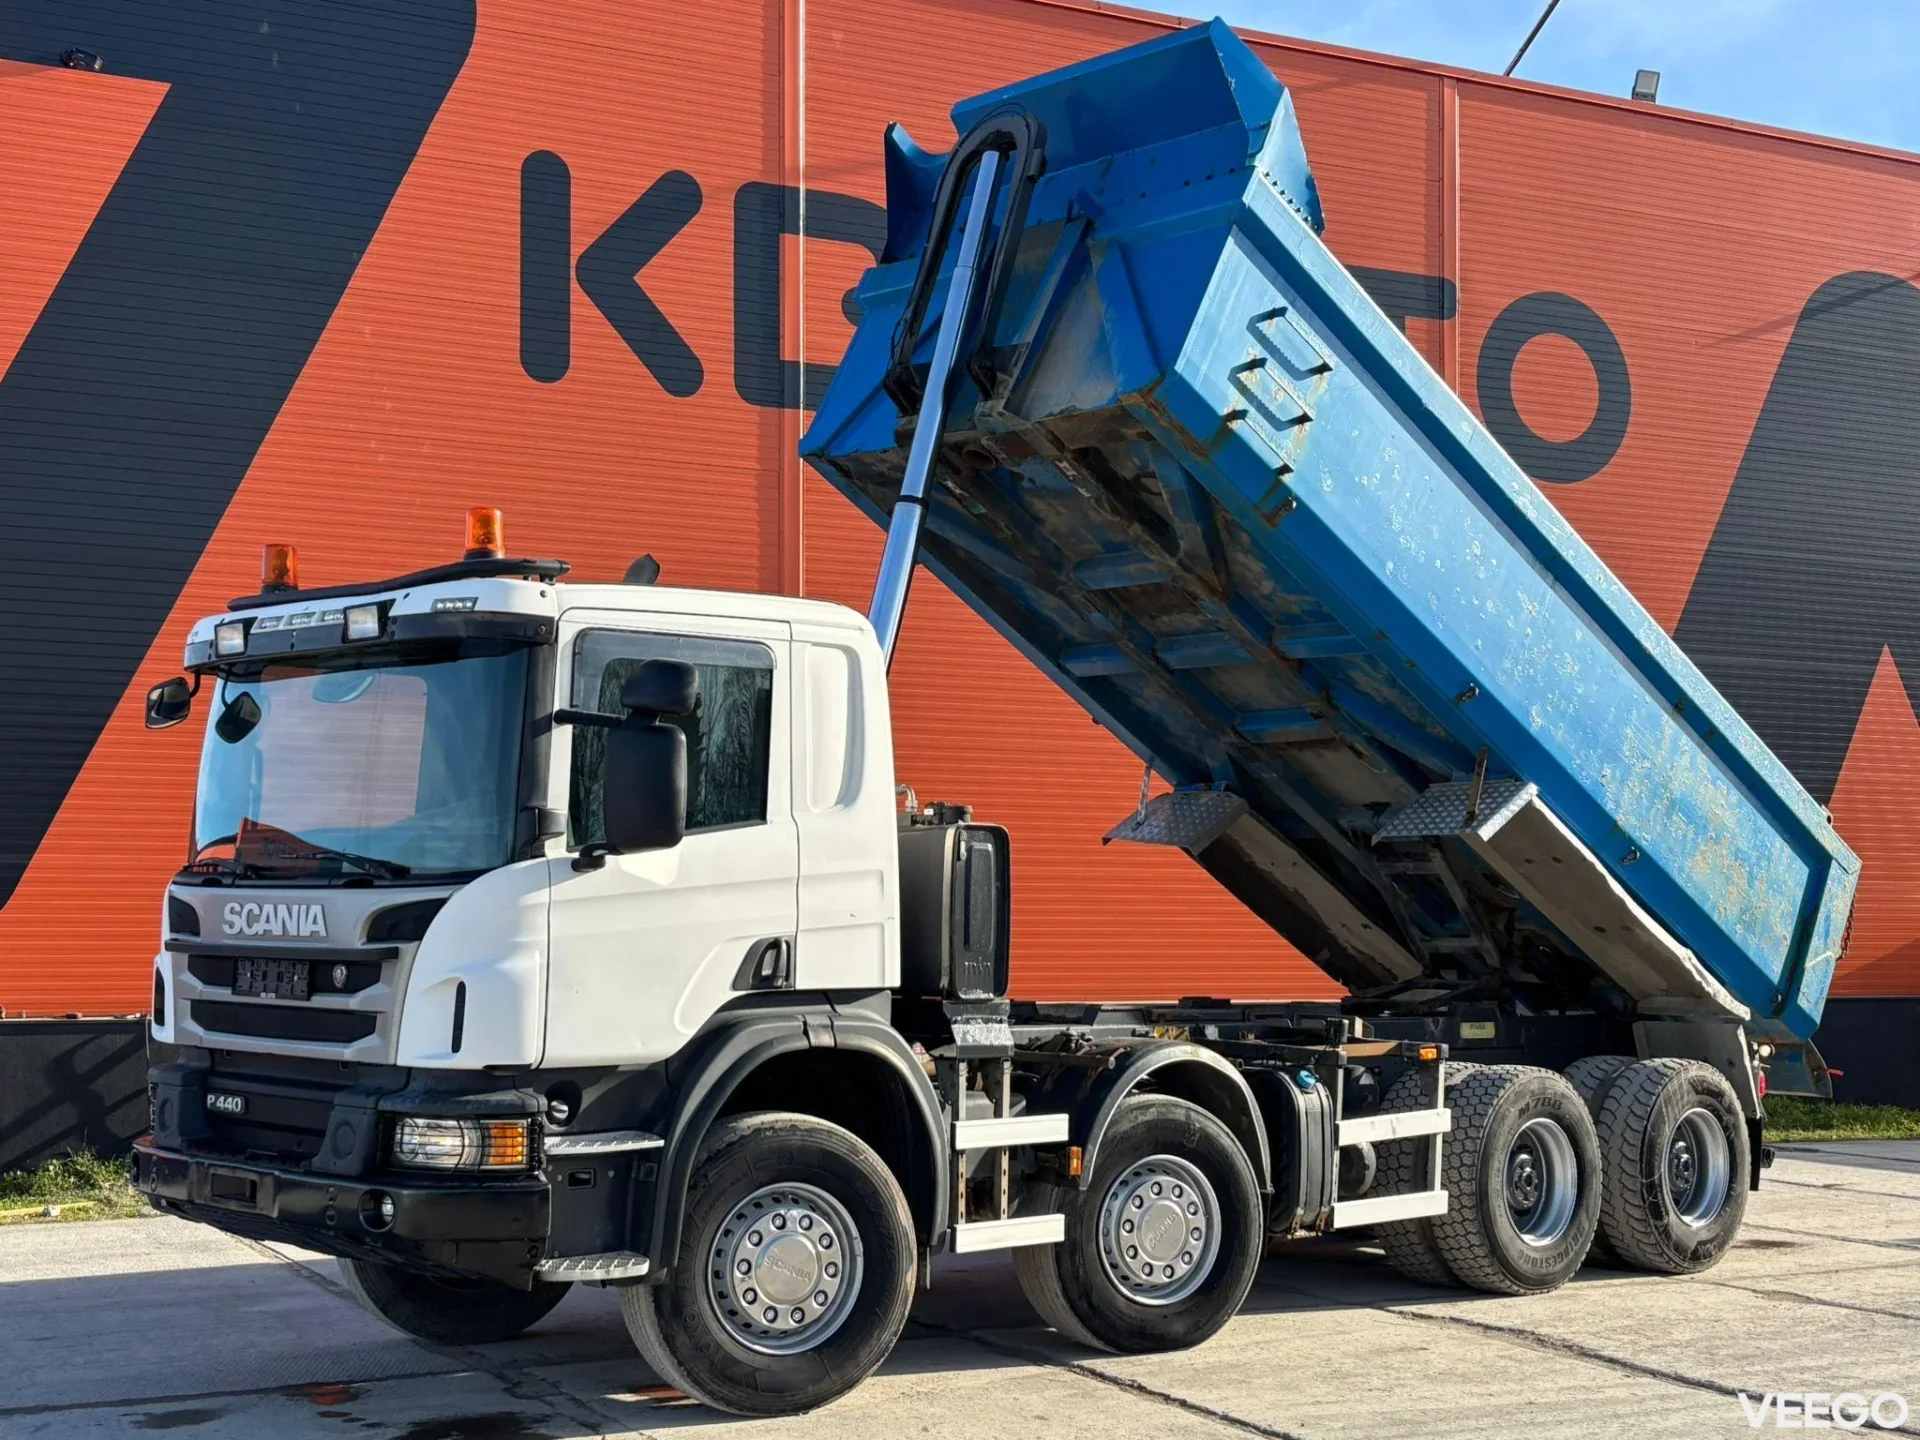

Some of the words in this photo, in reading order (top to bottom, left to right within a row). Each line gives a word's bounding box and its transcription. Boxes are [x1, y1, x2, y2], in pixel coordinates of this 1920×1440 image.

[222, 902, 328, 937] SCANIA
[206, 1094, 216, 1110] P
[216, 1095, 242, 1112] 440
[763, 1255, 812, 1285] SCANIA
